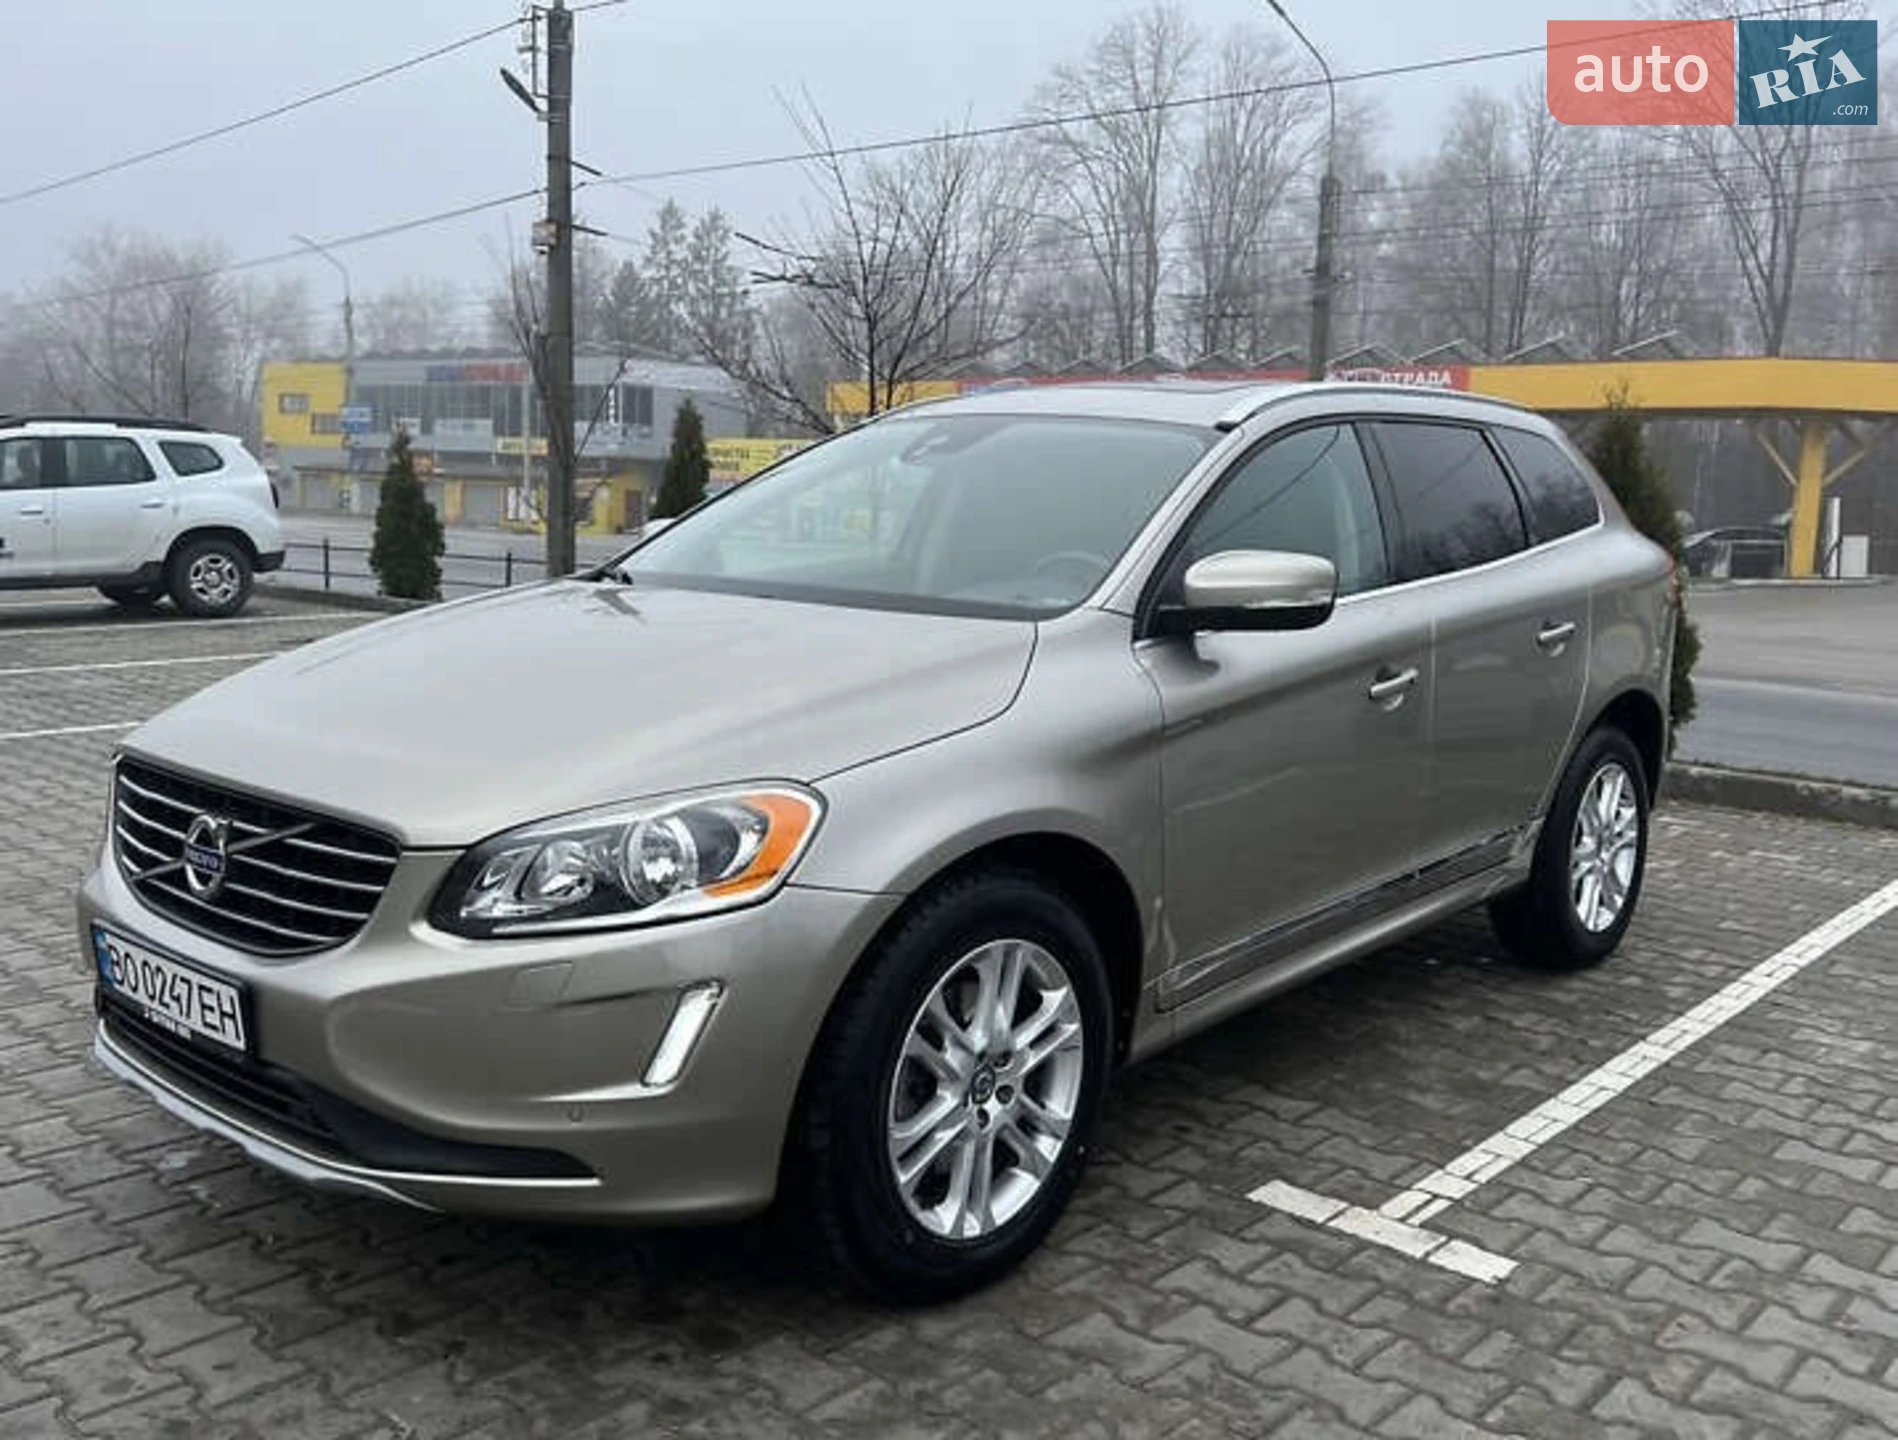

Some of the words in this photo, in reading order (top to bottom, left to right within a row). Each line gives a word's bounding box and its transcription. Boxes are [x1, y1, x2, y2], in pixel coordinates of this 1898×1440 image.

[107, 944, 138, 993] BO
[142, 960, 193, 1019] 0247
[198, 983, 242, 1041] EH
